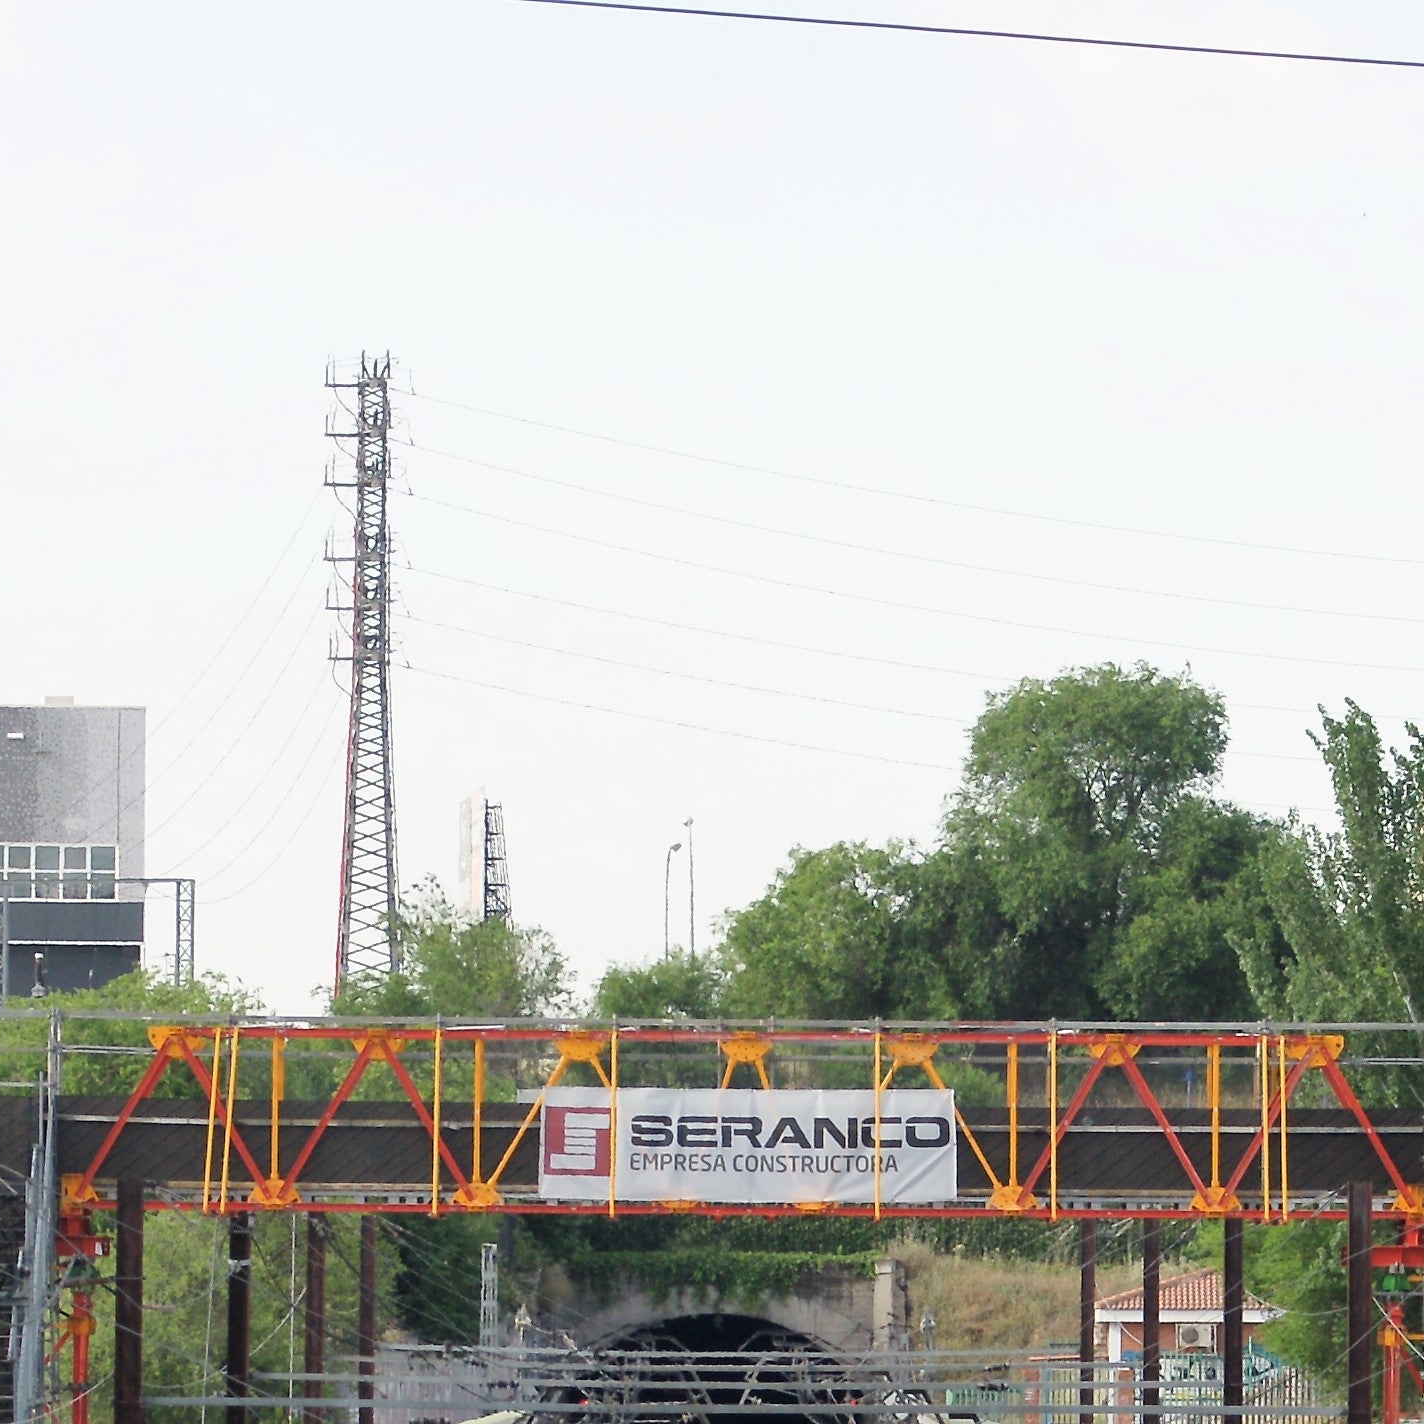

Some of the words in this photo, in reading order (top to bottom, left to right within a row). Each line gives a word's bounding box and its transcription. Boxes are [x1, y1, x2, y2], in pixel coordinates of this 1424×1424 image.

[630, 1115, 951, 1149] SERANCO
[630, 1153, 725, 1172] EMPRESA
[733, 1154, 898, 1173] CONSTRUCTORA
